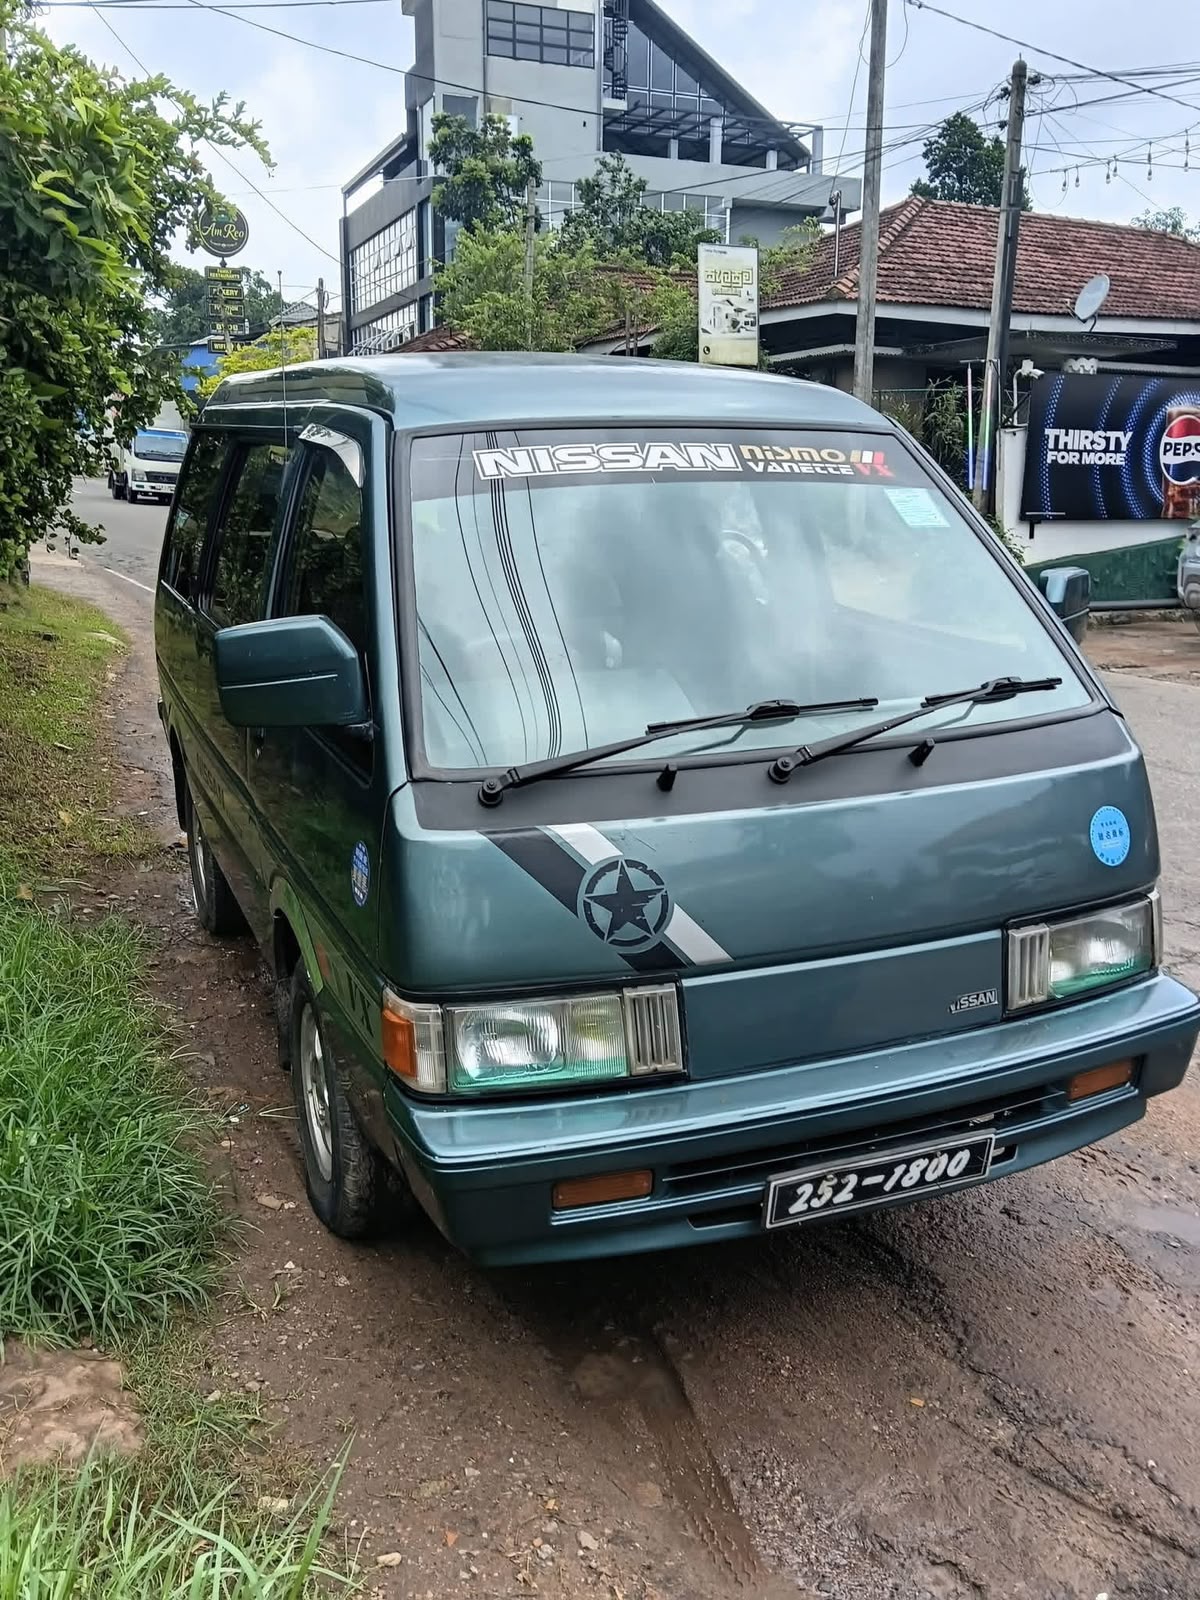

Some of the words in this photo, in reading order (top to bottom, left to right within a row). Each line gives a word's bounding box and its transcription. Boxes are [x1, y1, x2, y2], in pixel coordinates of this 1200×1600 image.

[1044, 428, 1133, 451] THIRSTY
[472, 443, 743, 480] NISSAN
[1047, 451, 1080, 464] FOR
[1082, 452, 1126, 466] MORE
[948, 990, 995, 1011] NISSAN
[788, 1149, 970, 1214] 252-1800
